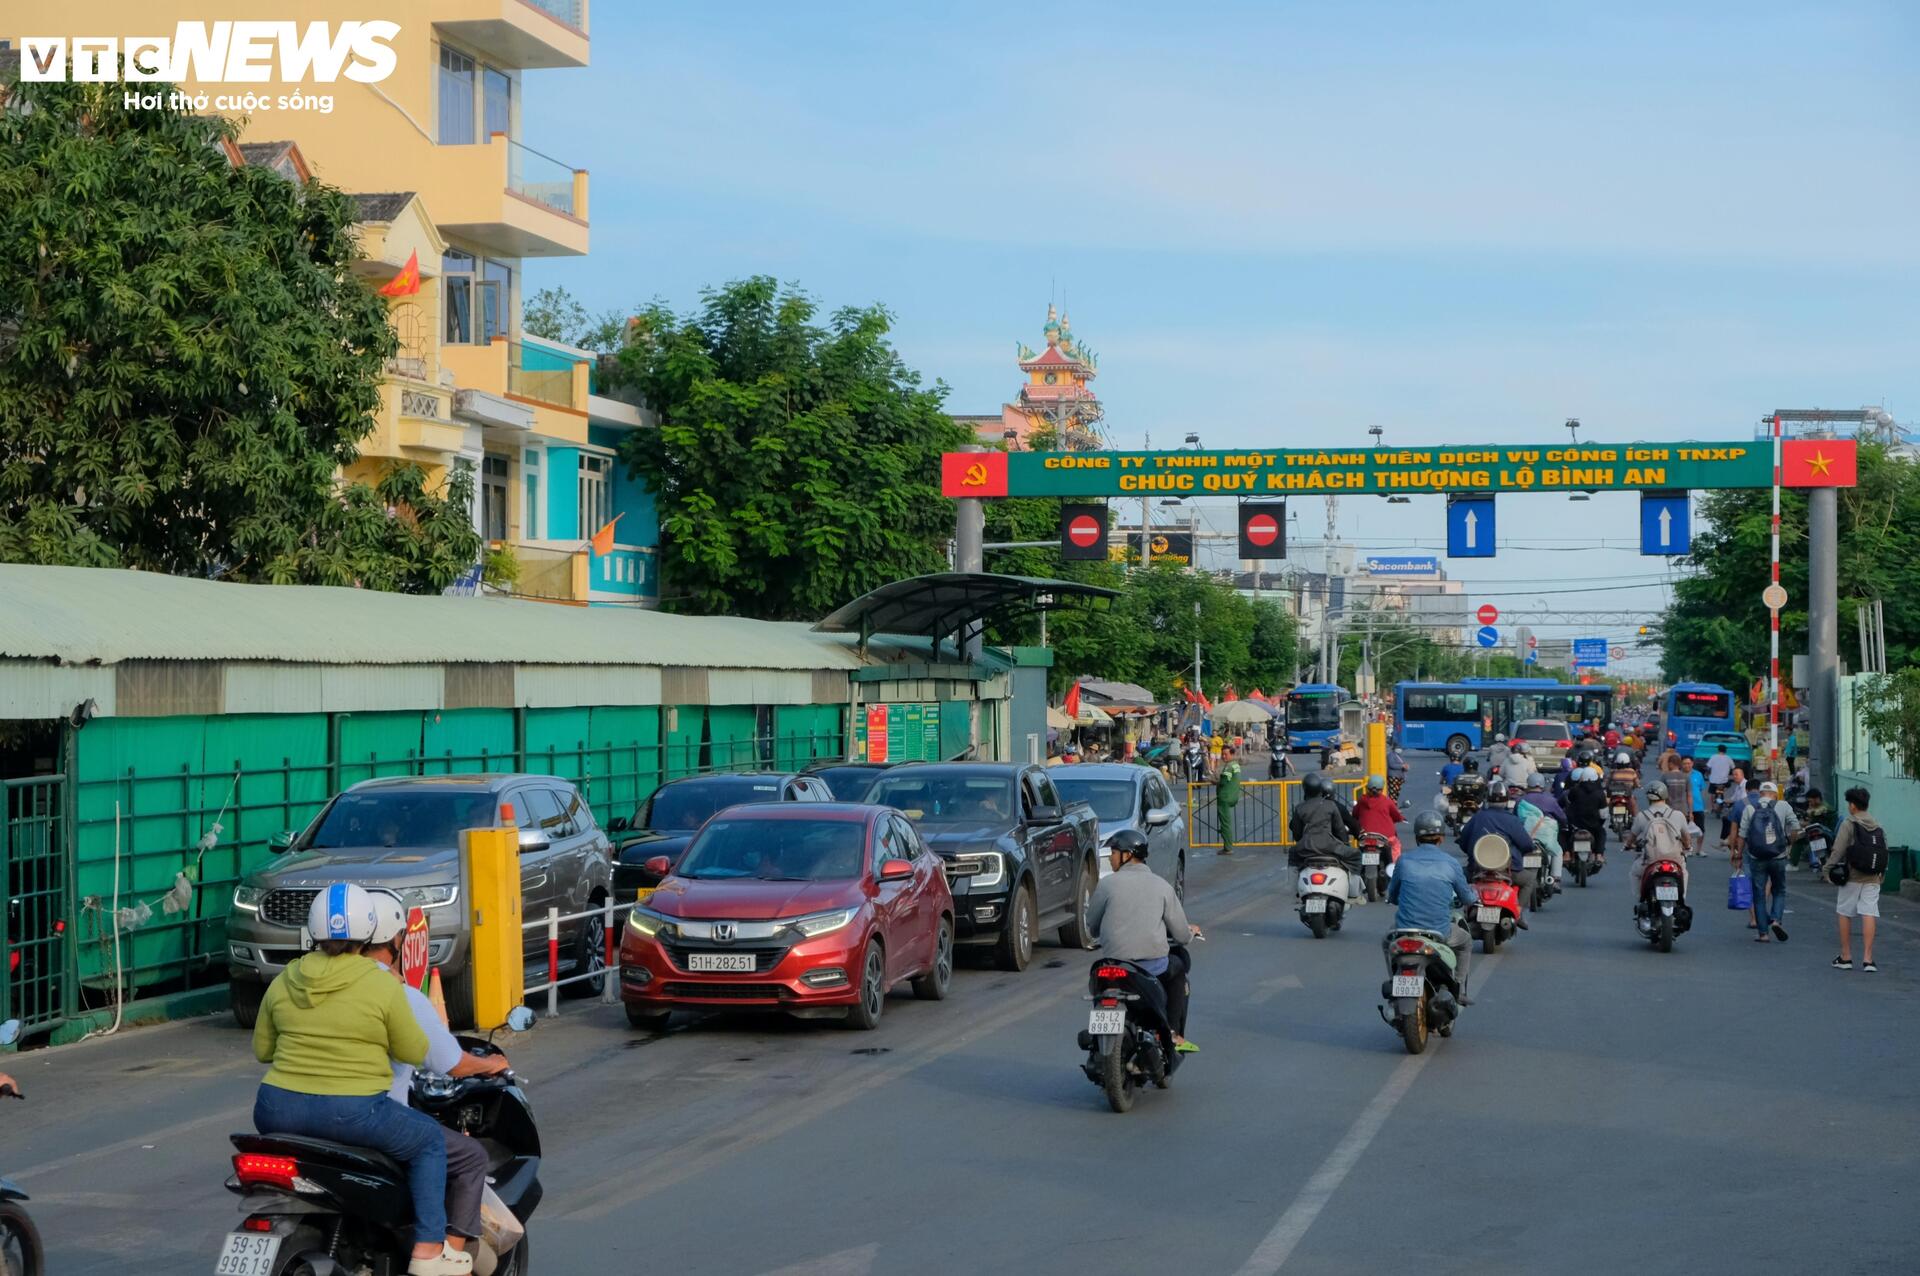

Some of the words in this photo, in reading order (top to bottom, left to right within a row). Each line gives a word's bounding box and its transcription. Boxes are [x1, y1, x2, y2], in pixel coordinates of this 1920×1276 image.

[1045, 455, 1110, 468] CÔNG
[1119, 457, 1146, 467] TY
[1154, 456, 1217, 467] TNHH
[1224, 452, 1277, 469] MỘT
[1284, 452, 1366, 466] THÀNH
[1374, 451, 1431, 464] VIÊN
[1439, 451, 1498, 466] DỊCH
[1507, 450, 1539, 465] VỤ
[1546, 448, 1617, 462] CÔNG
[1625, 447, 1669, 461] ÍCH
[1677, 448, 1746, 460] TNXP
[1119, 470, 1194, 490] CHÚC
[1203, 470, 1257, 490] QUÝ
[1267, 470, 1365, 489] KHÁCH
[1374, 469, 1490, 489] THƯỢNG
[1500, 467, 1535, 489] LỘ
[1542, 465, 1613, 485] BÌNH
[1624, 468, 1665, 485] AN
[1369, 560, 1433, 571] Sacombank
[404, 930, 426, 970] STOP
